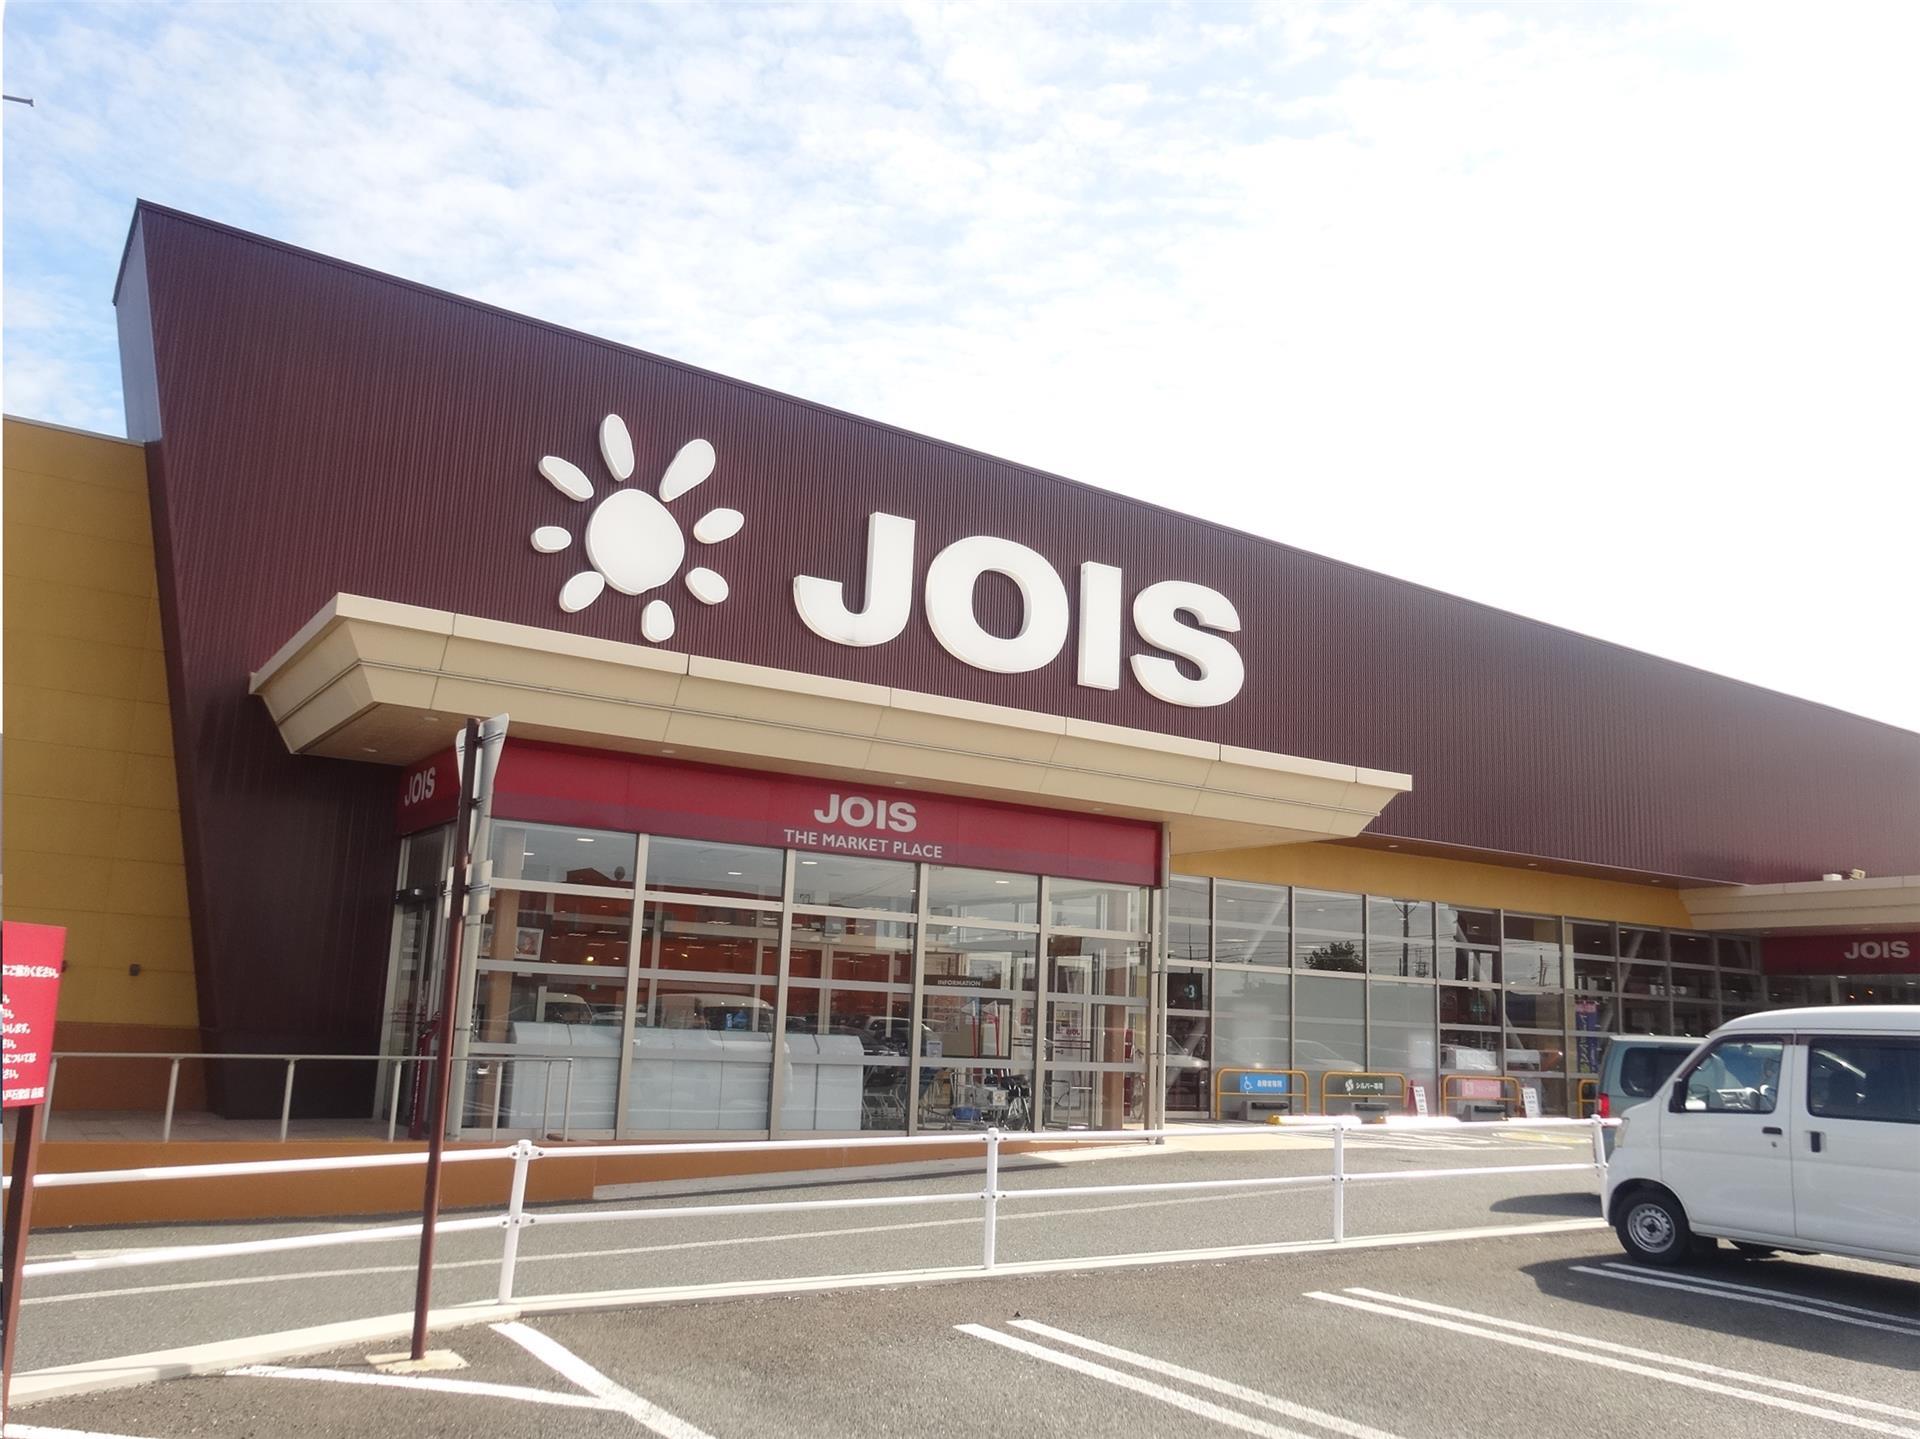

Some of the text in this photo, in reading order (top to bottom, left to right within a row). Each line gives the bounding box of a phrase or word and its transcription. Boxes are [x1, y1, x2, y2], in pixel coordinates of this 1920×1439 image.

[793, 511, 1245, 708] JOIS
[404, 766, 436, 807] JOIS
[813, 793, 917, 833] JOIS
[784, 829, 943, 858] THE MARKET PLACE
[1843, 940, 1910, 959] JOIS
[937, 979, 981, 987] INFORMATION
